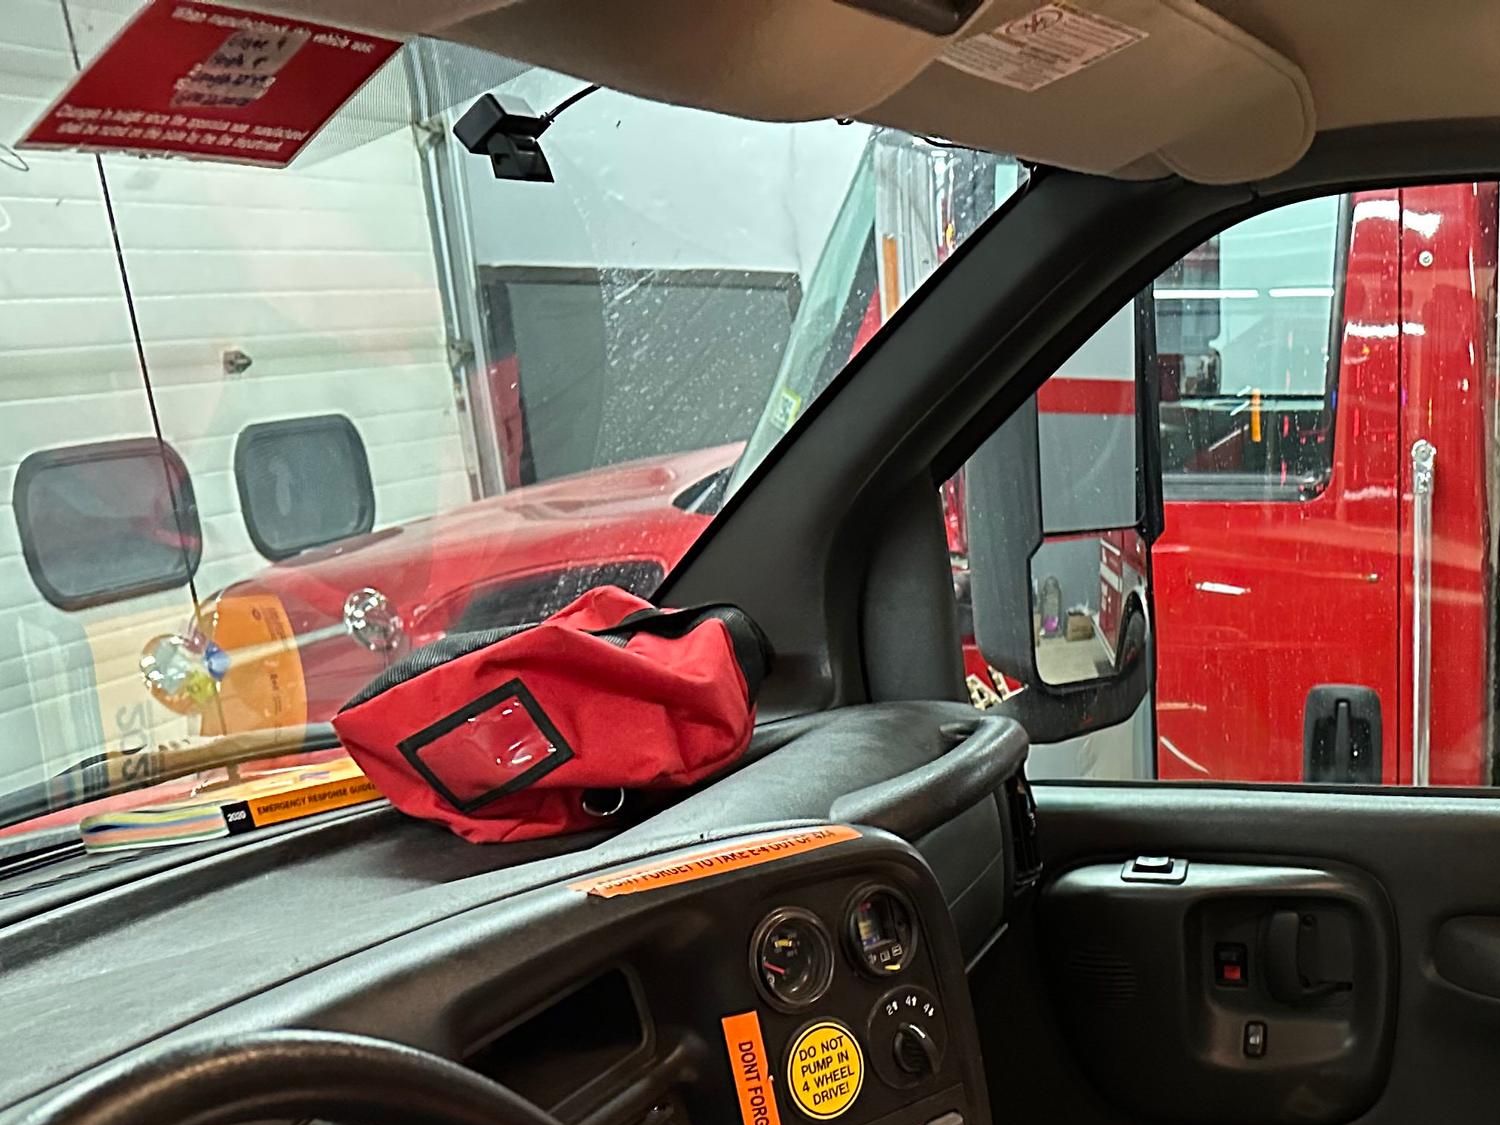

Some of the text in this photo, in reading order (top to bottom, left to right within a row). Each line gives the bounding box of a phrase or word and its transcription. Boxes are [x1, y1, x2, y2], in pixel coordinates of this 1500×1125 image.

[227, 810, 246, 822] 2020
[257, 798, 307, 816] EMERGENCY
[307, 788, 348, 804] RESPONSE
[738, 1040, 761, 1082] DONT
[799, 1035, 844, 1062] DO NOT
[801, 1050, 849, 1077] PUMP IN
[802, 1065, 855, 1092] 4 WHEEL
[813, 1081, 850, 1106] DRIVE!
